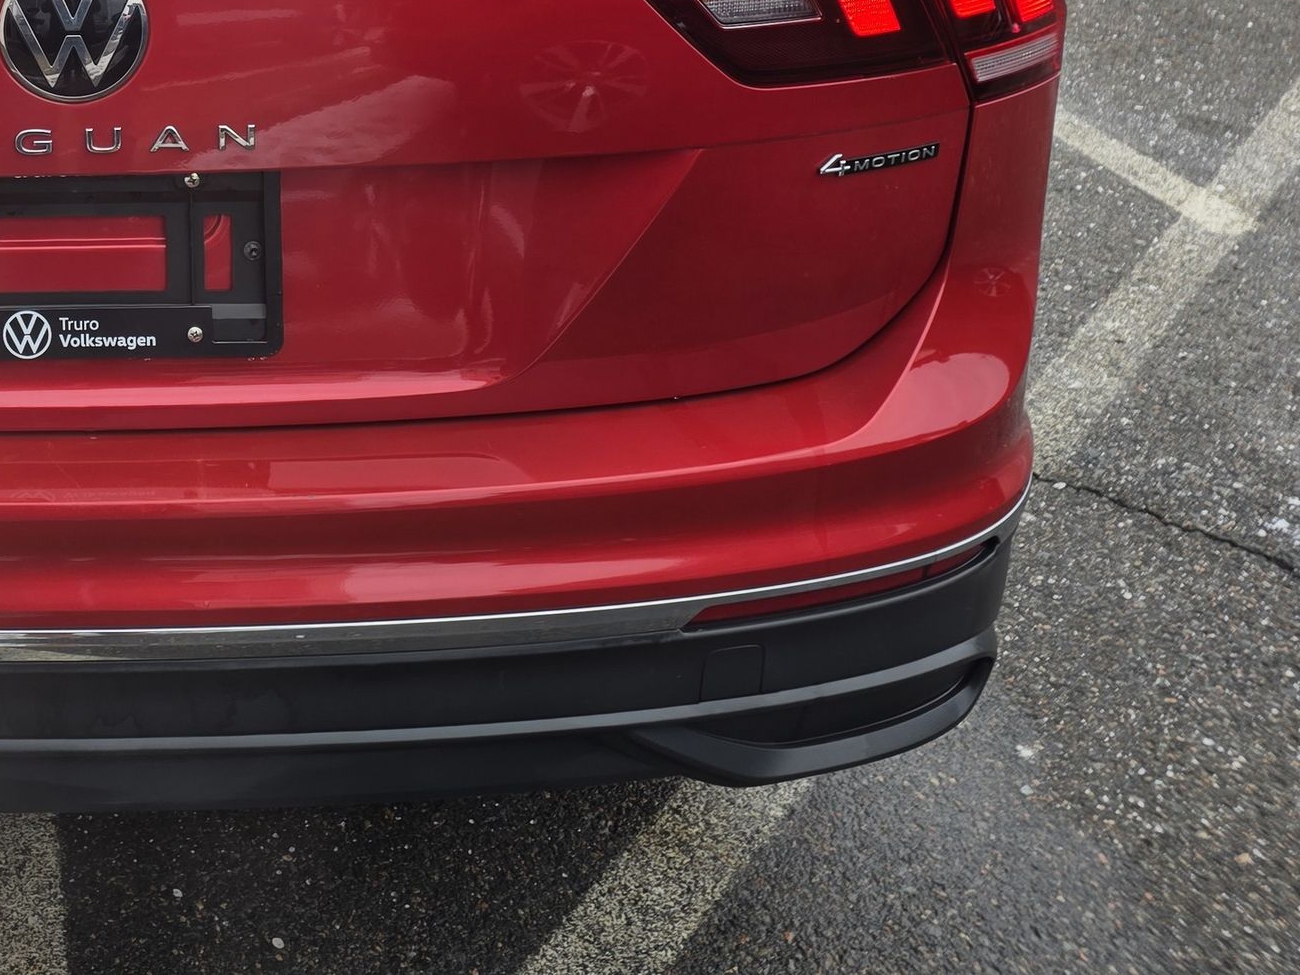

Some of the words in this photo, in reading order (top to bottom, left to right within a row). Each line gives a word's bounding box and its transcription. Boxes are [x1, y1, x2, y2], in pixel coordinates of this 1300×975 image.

[59, 317, 100, 331] Truro
[3, 310, 52, 360] VW
[59, 333, 157, 351] Volkswagen
